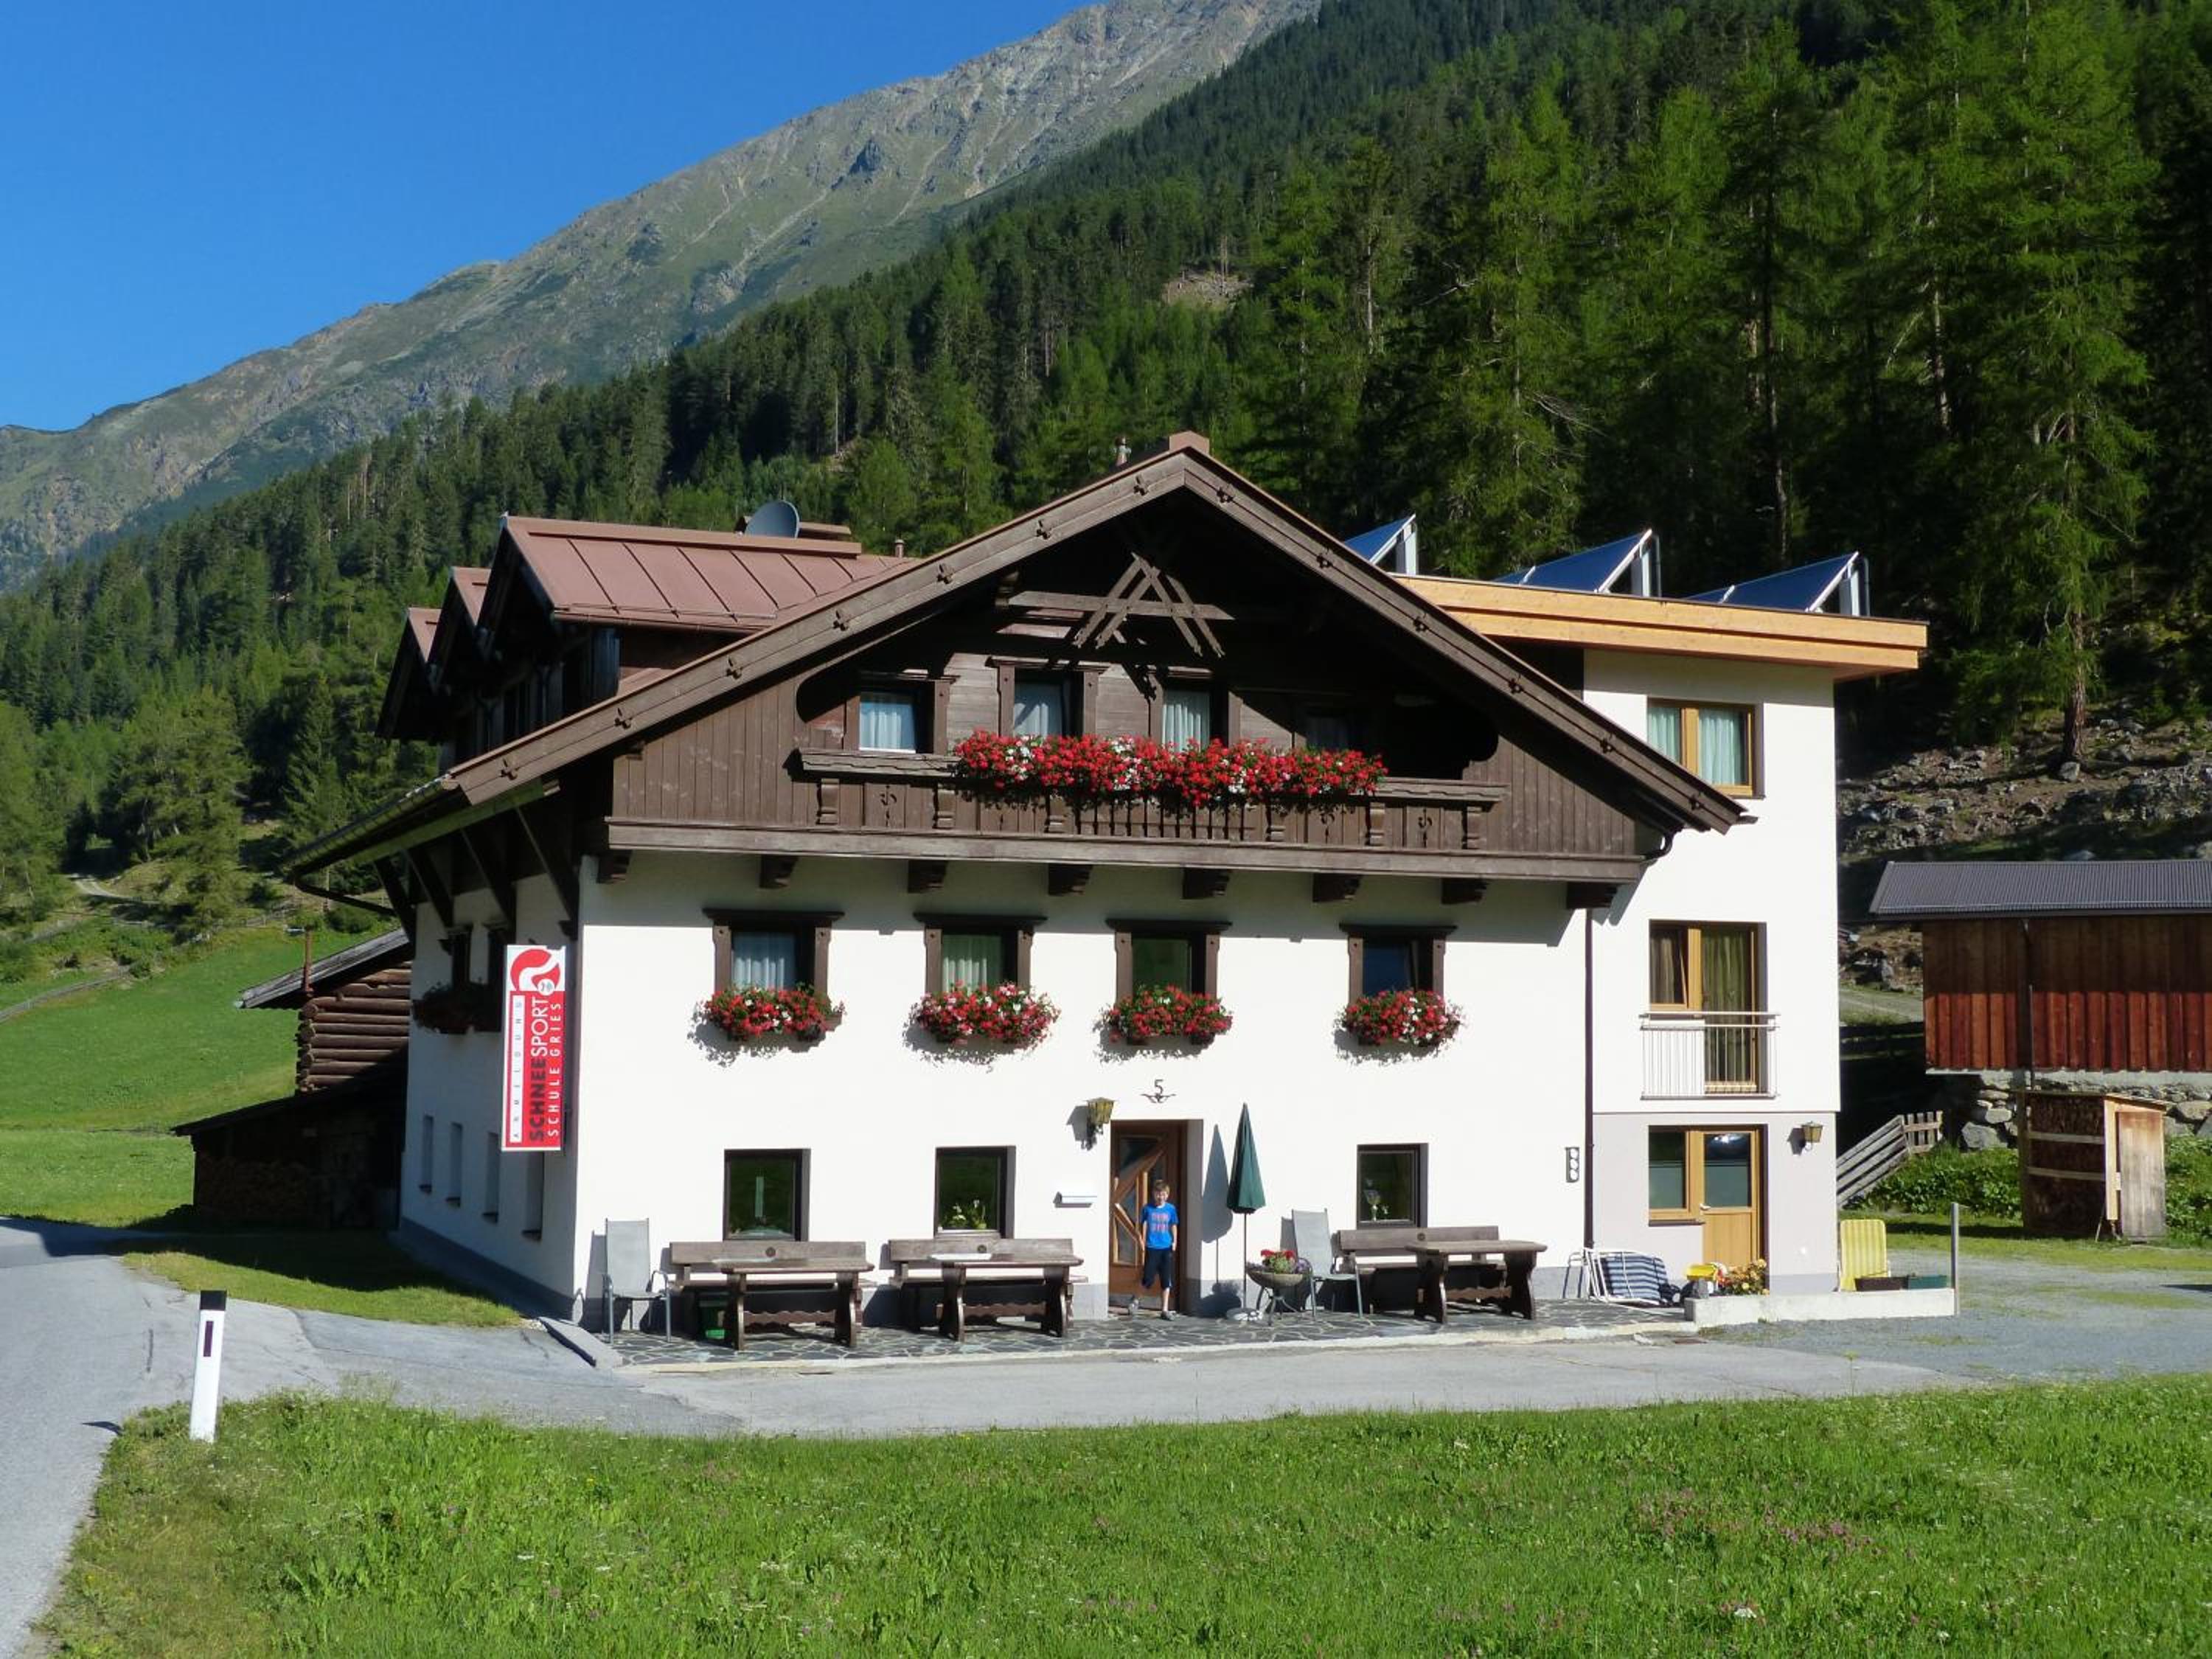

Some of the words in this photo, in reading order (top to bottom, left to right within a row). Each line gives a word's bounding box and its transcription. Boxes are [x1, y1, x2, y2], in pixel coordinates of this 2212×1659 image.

[550, 1003, 561, 1057] GRIES
[548, 1067, 560, 1137] SCHULE
[1154, 1079, 1164, 1095] 5
